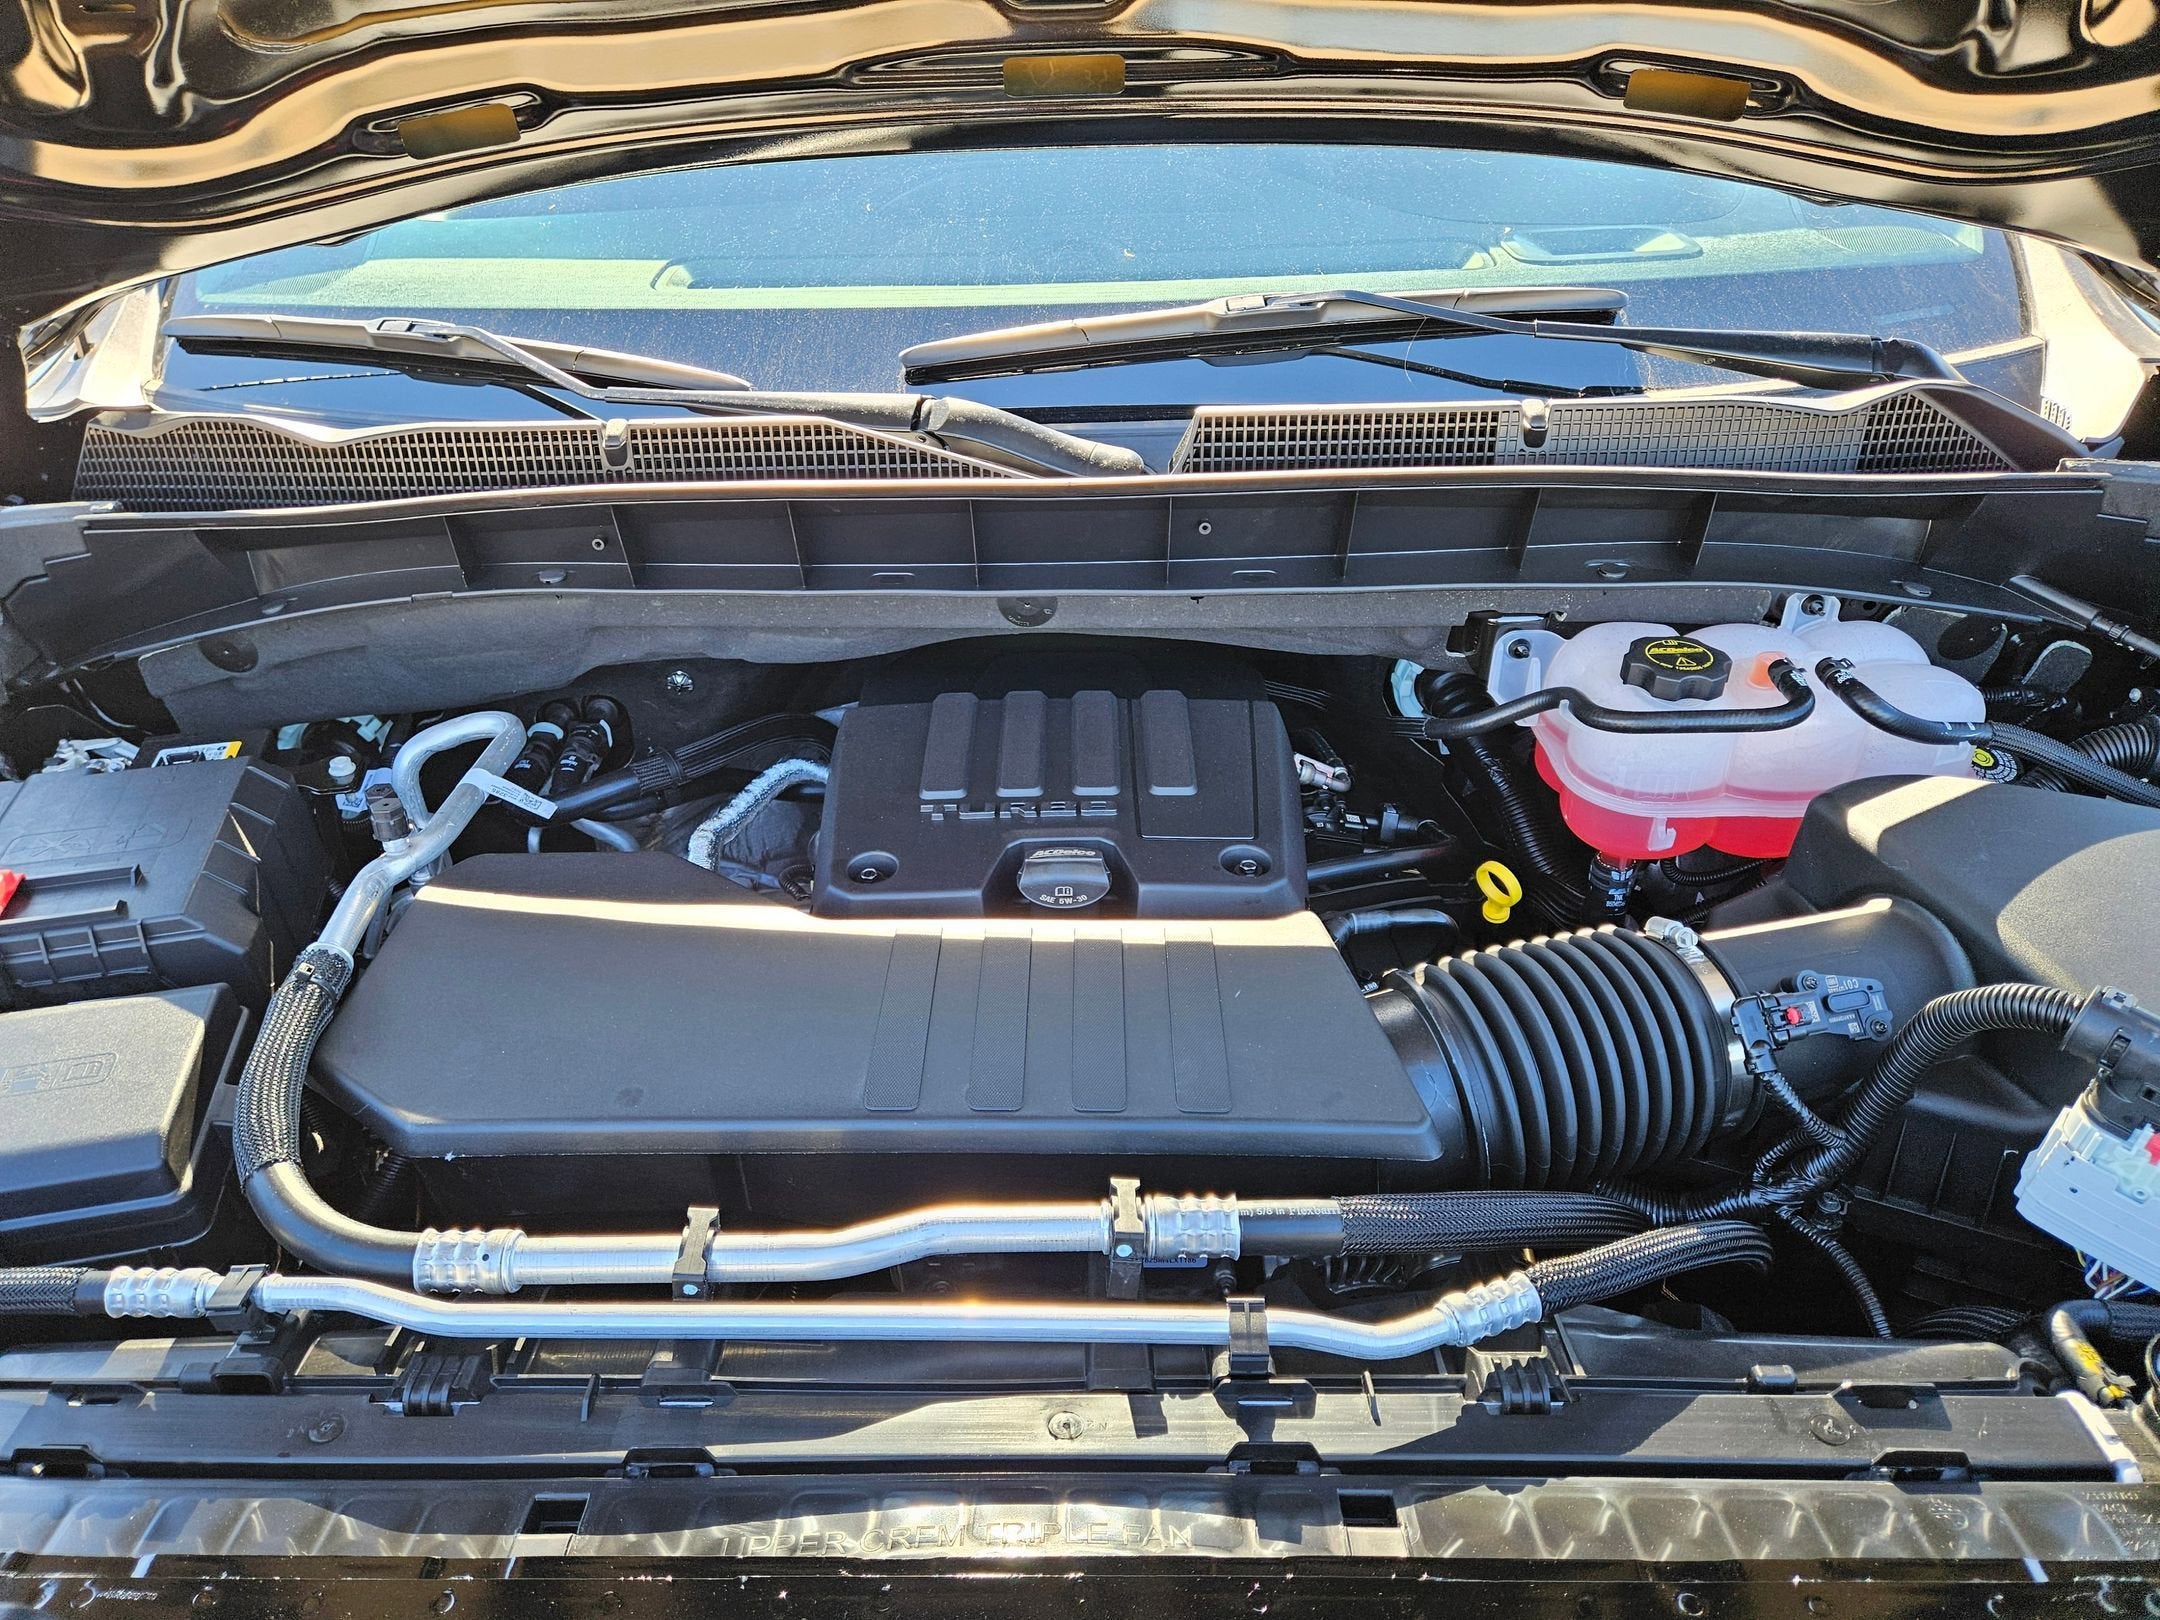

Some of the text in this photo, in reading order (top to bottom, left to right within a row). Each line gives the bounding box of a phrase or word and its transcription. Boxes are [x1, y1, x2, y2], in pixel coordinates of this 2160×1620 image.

[1648, 647, 1704, 655] ACDelco
[920, 800, 1118, 821] TURBO
[1030, 848, 1096, 859] ACDelco
[1039, 894, 1088, 905] SAE 5W-30
[719, 1521, 1194, 1558] UPPER CRFM TRIPLE FAN
